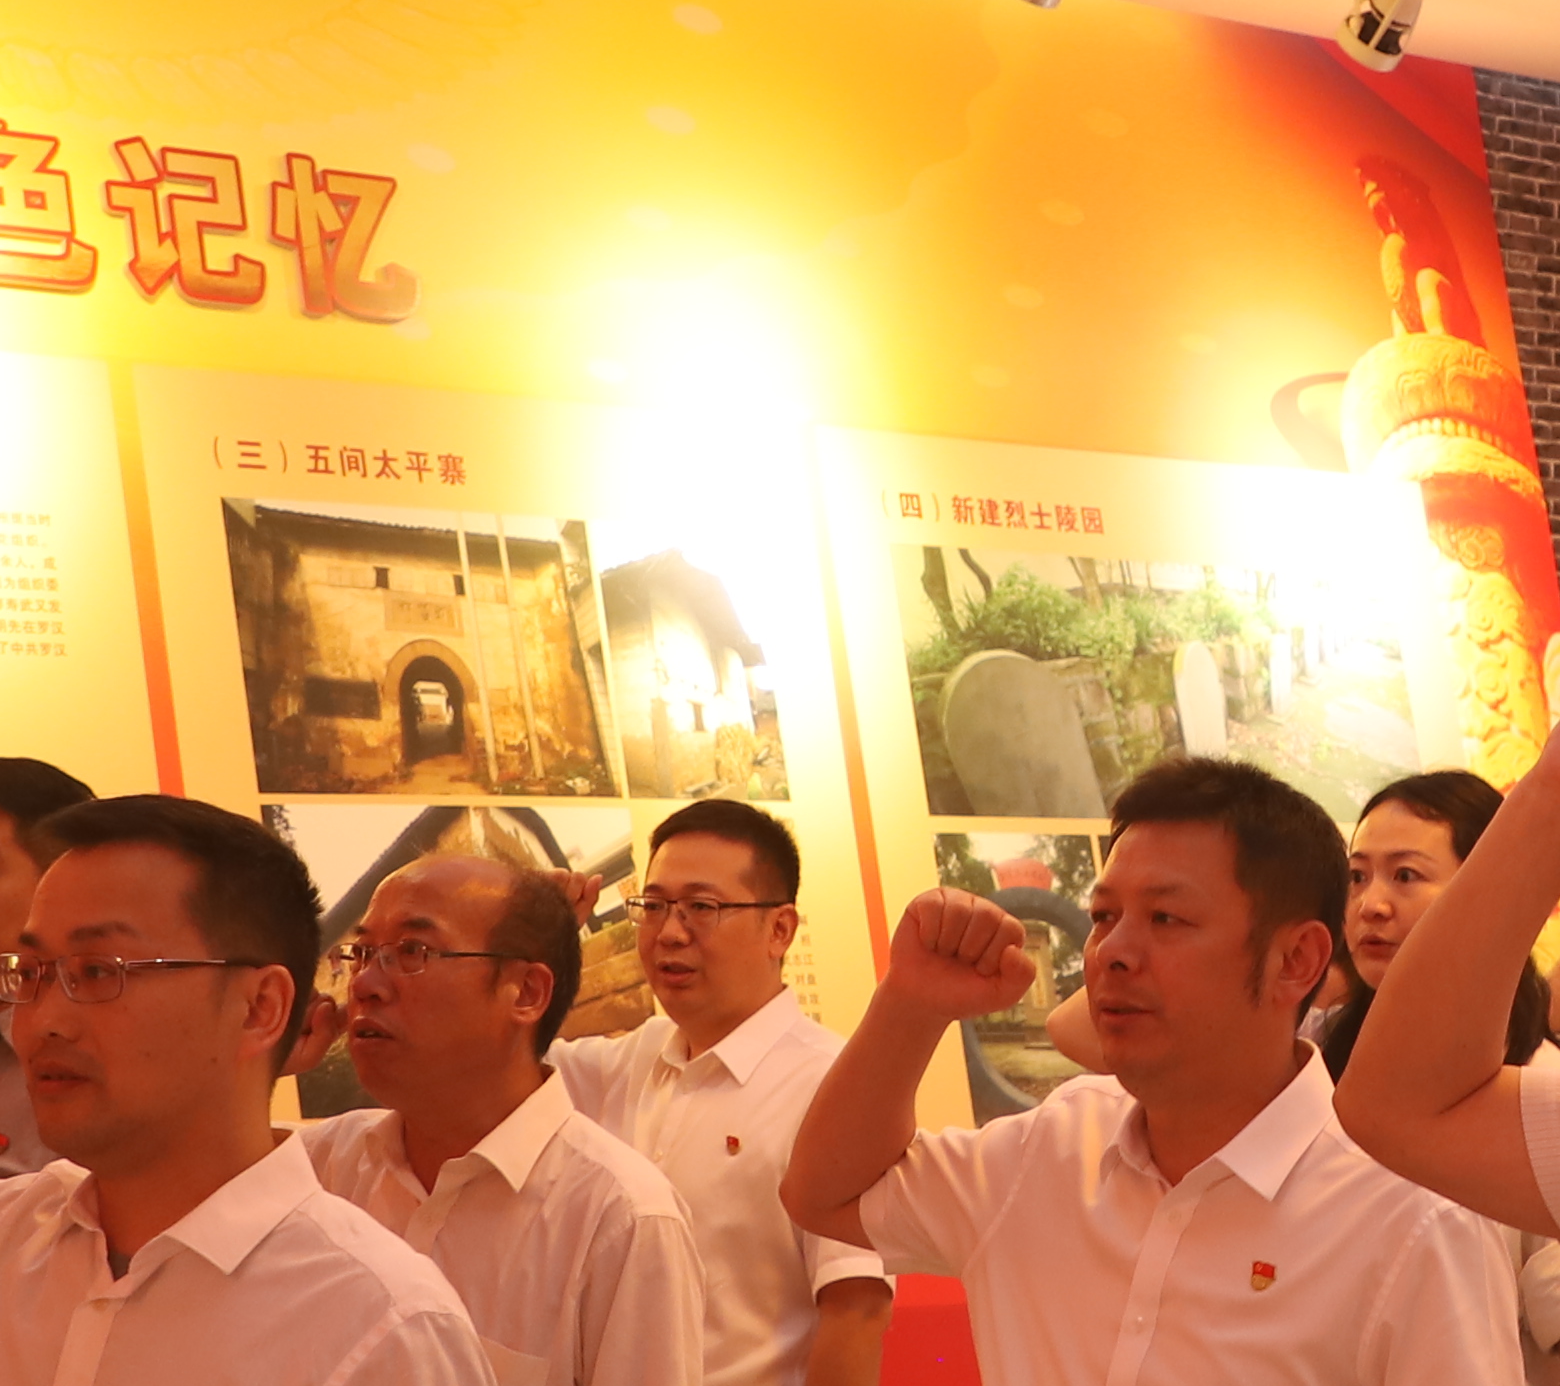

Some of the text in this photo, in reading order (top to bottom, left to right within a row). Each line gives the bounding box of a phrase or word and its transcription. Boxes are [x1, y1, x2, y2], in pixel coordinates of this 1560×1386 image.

[212, 435, 467, 486] （三）五间太平寨
[881, 490, 1105, 536] （四）新建烈士陵园
